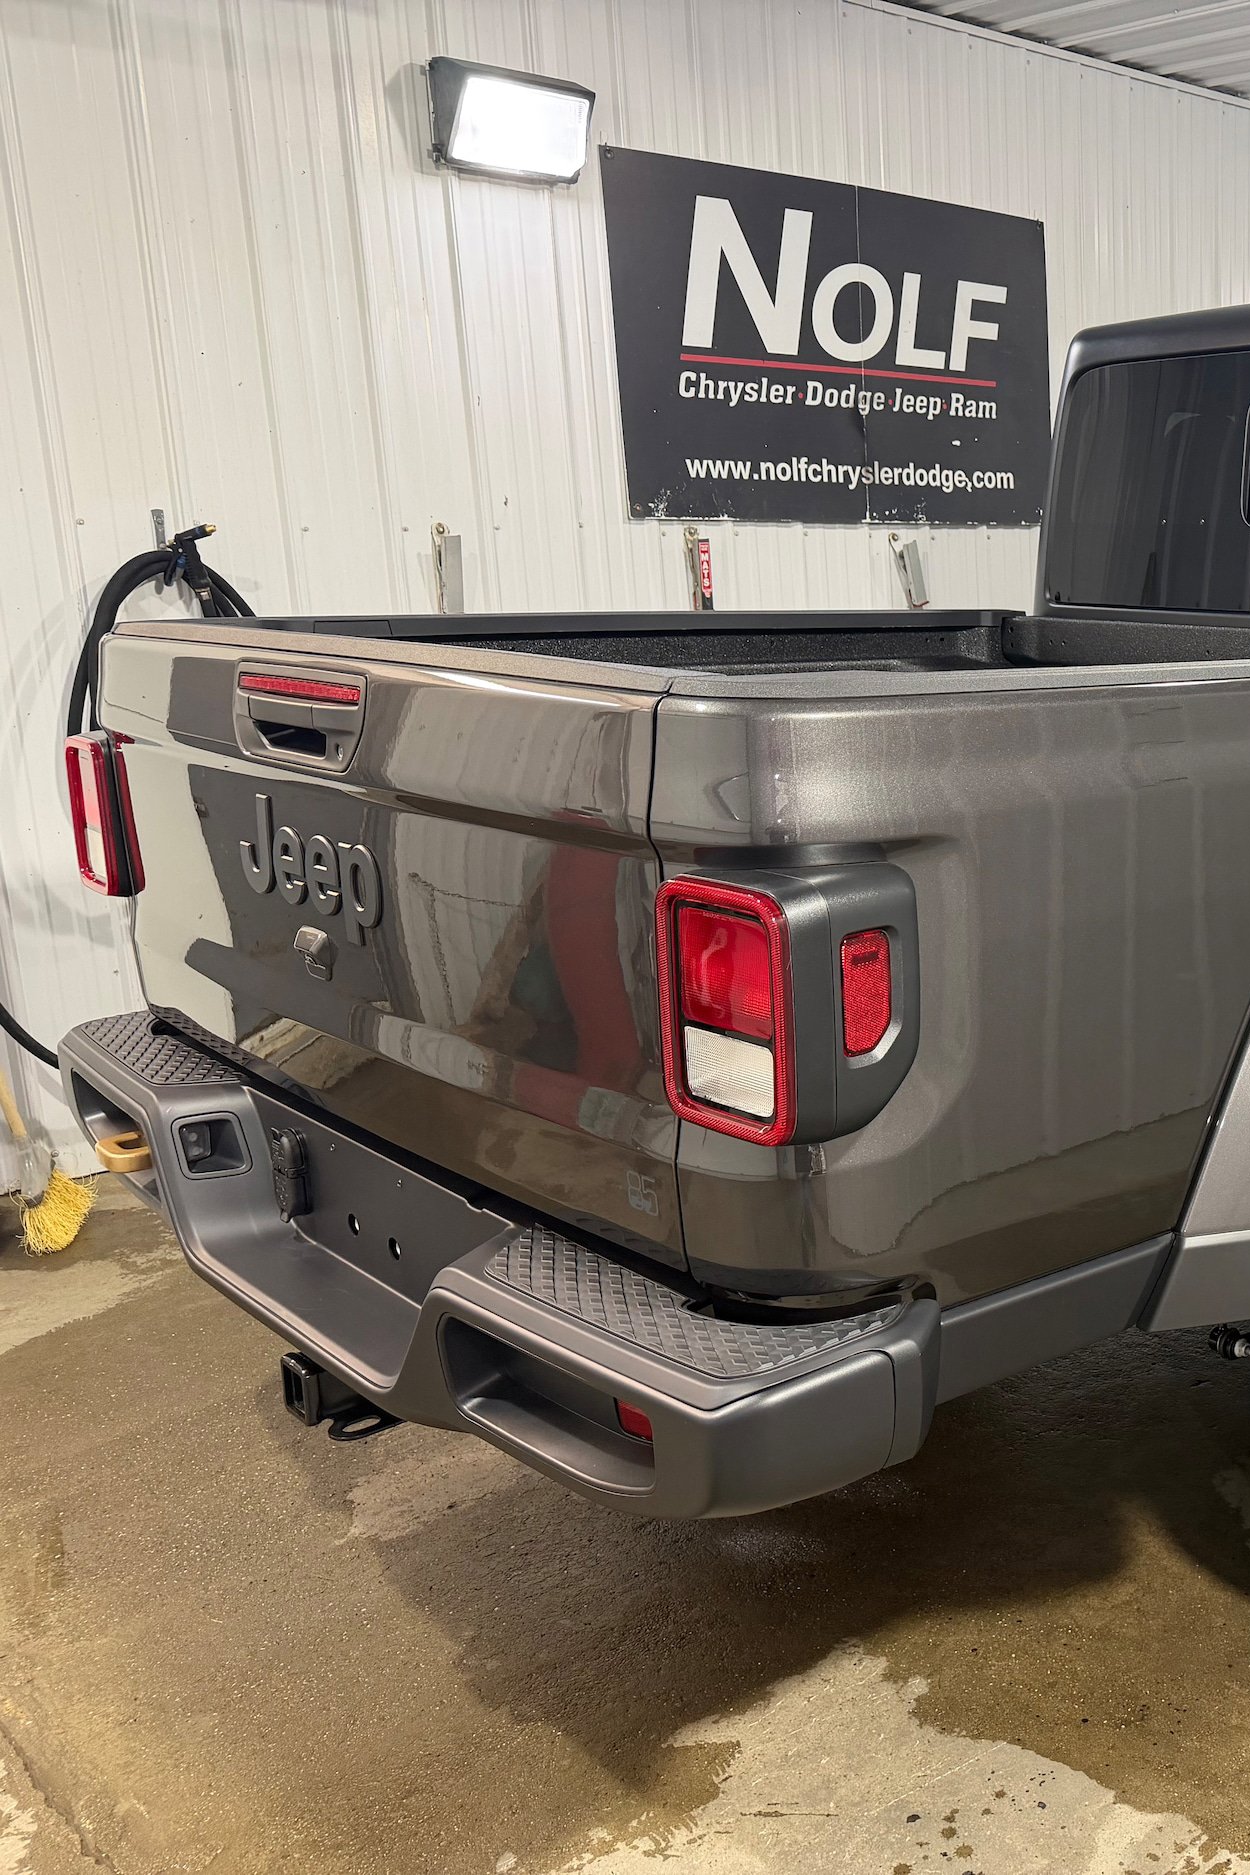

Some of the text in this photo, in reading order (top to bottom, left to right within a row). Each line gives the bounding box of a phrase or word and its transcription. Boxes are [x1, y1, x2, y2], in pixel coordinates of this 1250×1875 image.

[682, 195, 1008, 372] NOLF
[678, 370, 997, 421] Chrysler Dodge Jeep Ram
[685, 457, 1015, 493] www.nolfchryslerdodge.com
[240, 793, 383, 946] Jeep
[626, 1170, 659, 1217] 85
